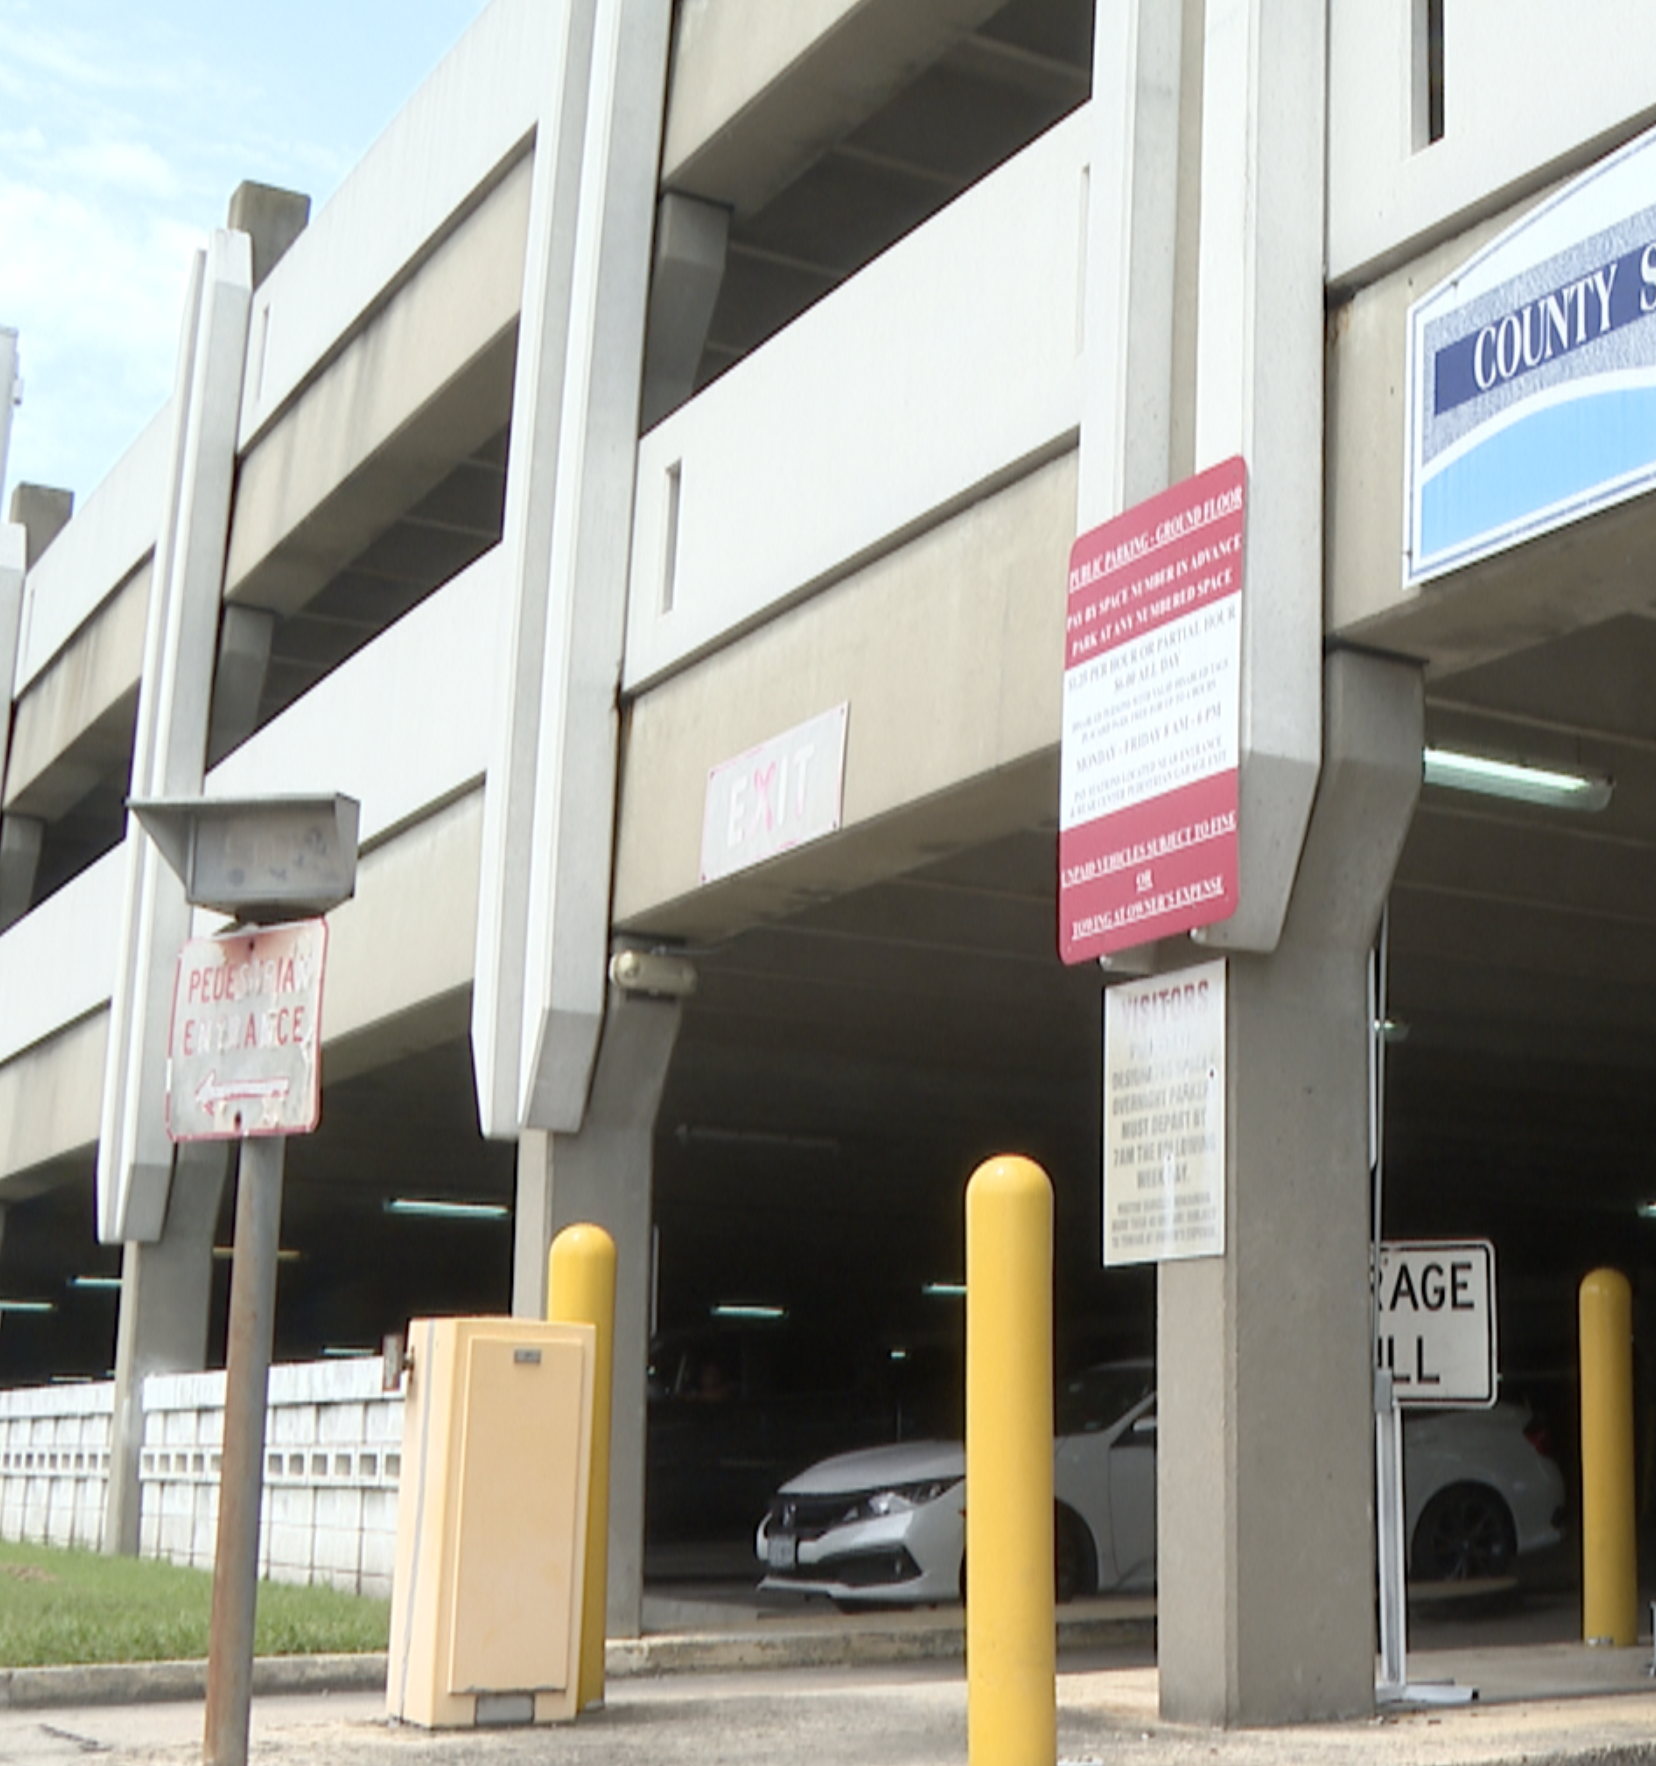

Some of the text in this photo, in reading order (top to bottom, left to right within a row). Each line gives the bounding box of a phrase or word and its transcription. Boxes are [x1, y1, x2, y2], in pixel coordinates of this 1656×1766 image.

[1471, 265, 1617, 392] COUNTY
[1068, 556, 1102, 592] PUBLIC
[1103, 534, 1149, 574] PARKING
[1154, 505, 1202, 549] GROUND
[1202, 485, 1242, 525] FLOOR
[727, 742, 816, 849] EXIT
[1136, 869, 1153, 892] OR
[1121, 978, 1209, 1031] VISITORS
[1122, 1117, 1149, 1140] MUST
[1151, 1110, 1190, 1135] DEPART
[1377, 1335, 1440, 1385] LL
